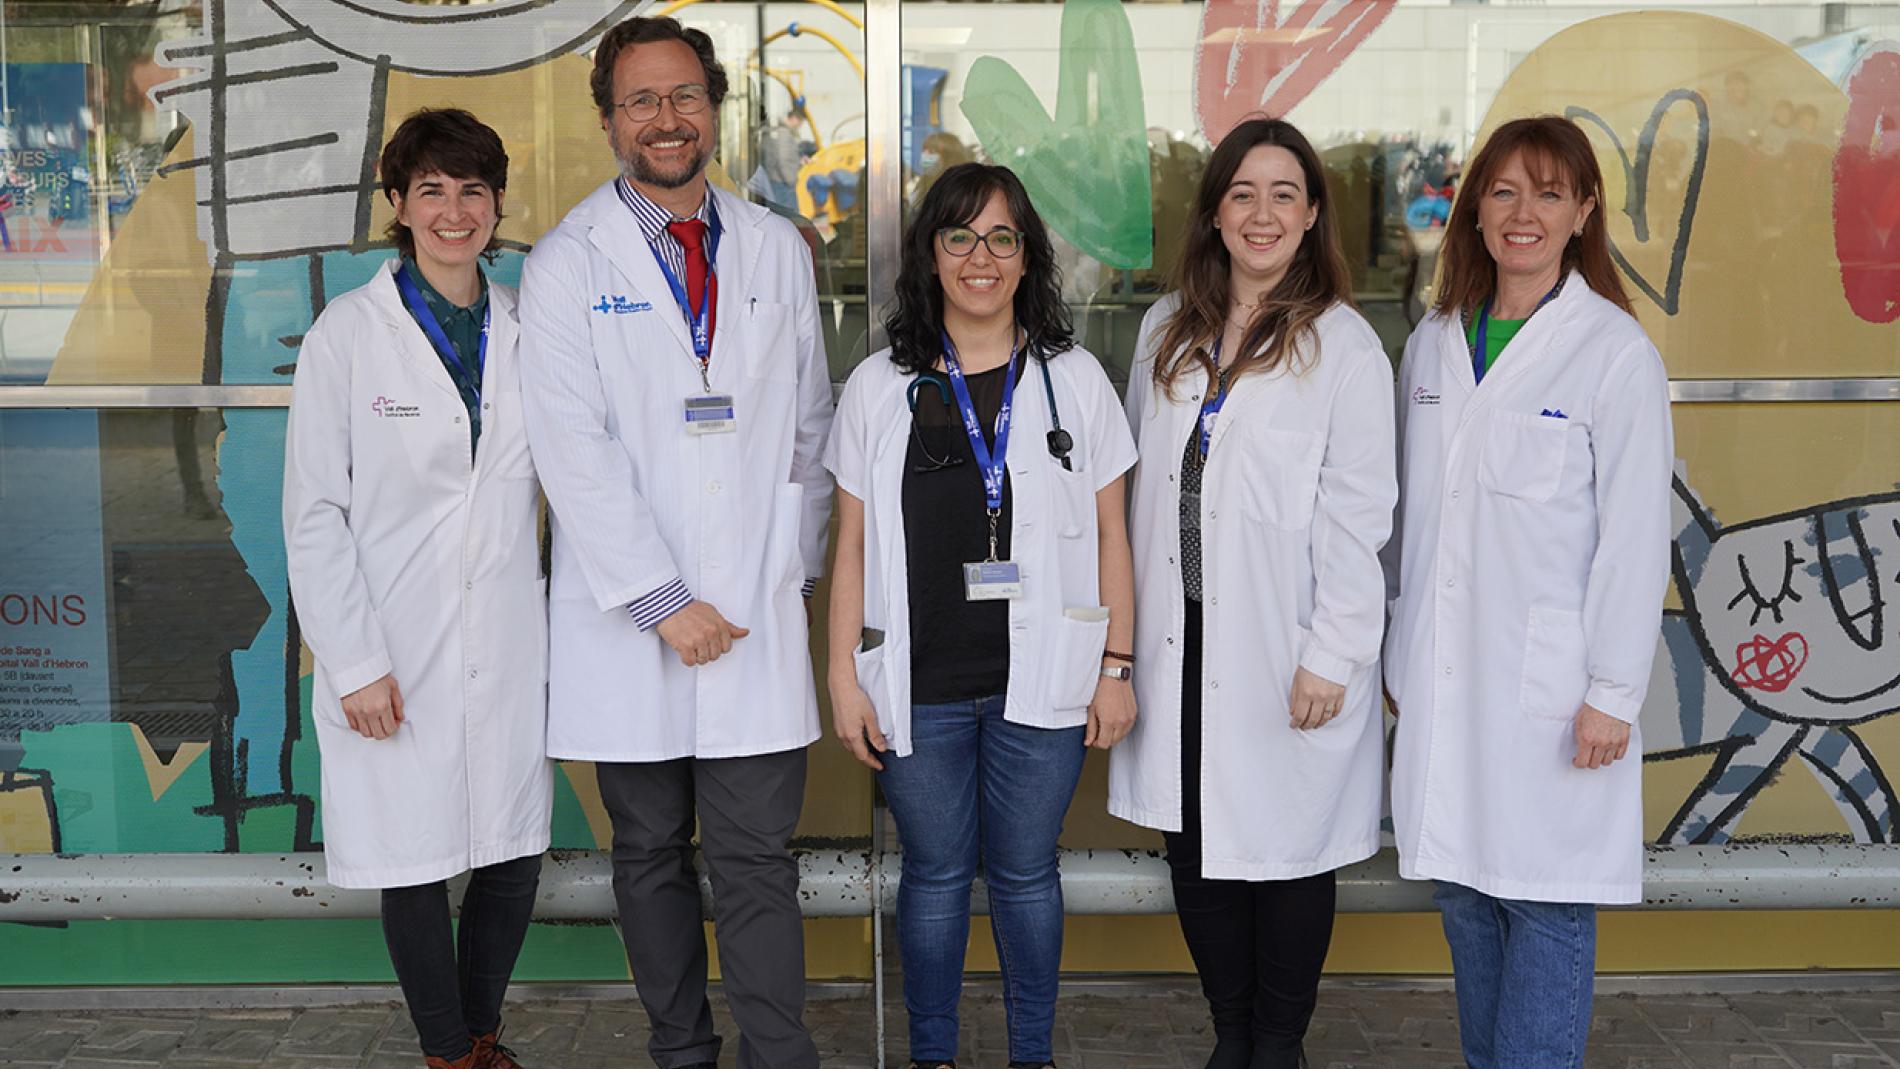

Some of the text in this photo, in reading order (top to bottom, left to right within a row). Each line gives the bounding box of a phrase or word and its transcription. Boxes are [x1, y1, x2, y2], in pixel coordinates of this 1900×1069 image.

[16, 646, 42, 657] Sang
[44, 647, 52, 656] a
[21, 660, 40, 668] Vall
[42, 660, 89, 669] d'Hebron
